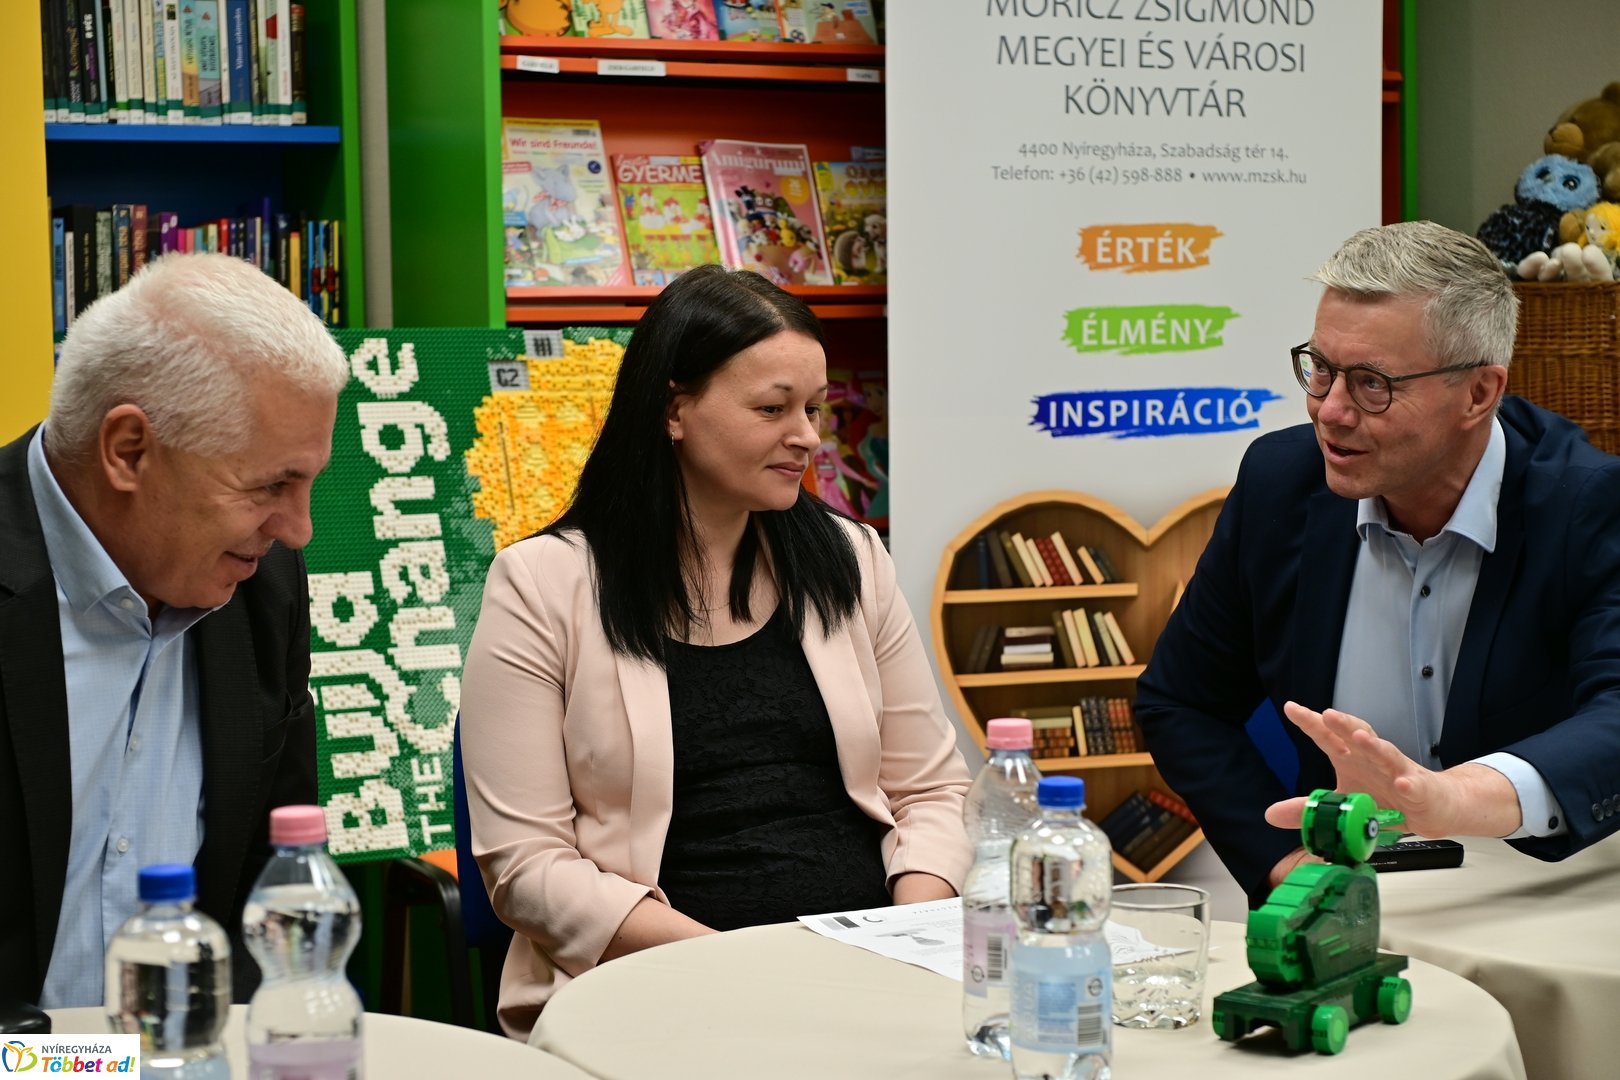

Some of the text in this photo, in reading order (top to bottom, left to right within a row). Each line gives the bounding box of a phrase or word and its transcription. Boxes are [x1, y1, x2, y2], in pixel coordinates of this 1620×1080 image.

[1134, 0, 1315, 25] ZSIGMOND
[996, 31, 1306, 72] MEGYEI ÉS VÁROSI
[1063, 78, 1247, 118] KÖNYVTÁR
[1018, 142, 1289, 162] 4400 Nyíregyháza, Szabadság tér 14.
[618, 165, 702, 183] GYERME
[992, 165, 1307, 185] Telefon: +36 (42) 598-888 www.mzsk.hu
[1096, 230, 1197, 264] ÉRTÉK
[1081, 312, 1213, 346] ÉLMÉNY
[1049, 391, 1252, 428] INSPIRÁCIÓ
[350, 338, 463, 845] THE Change
[308, 571, 410, 855] Build
